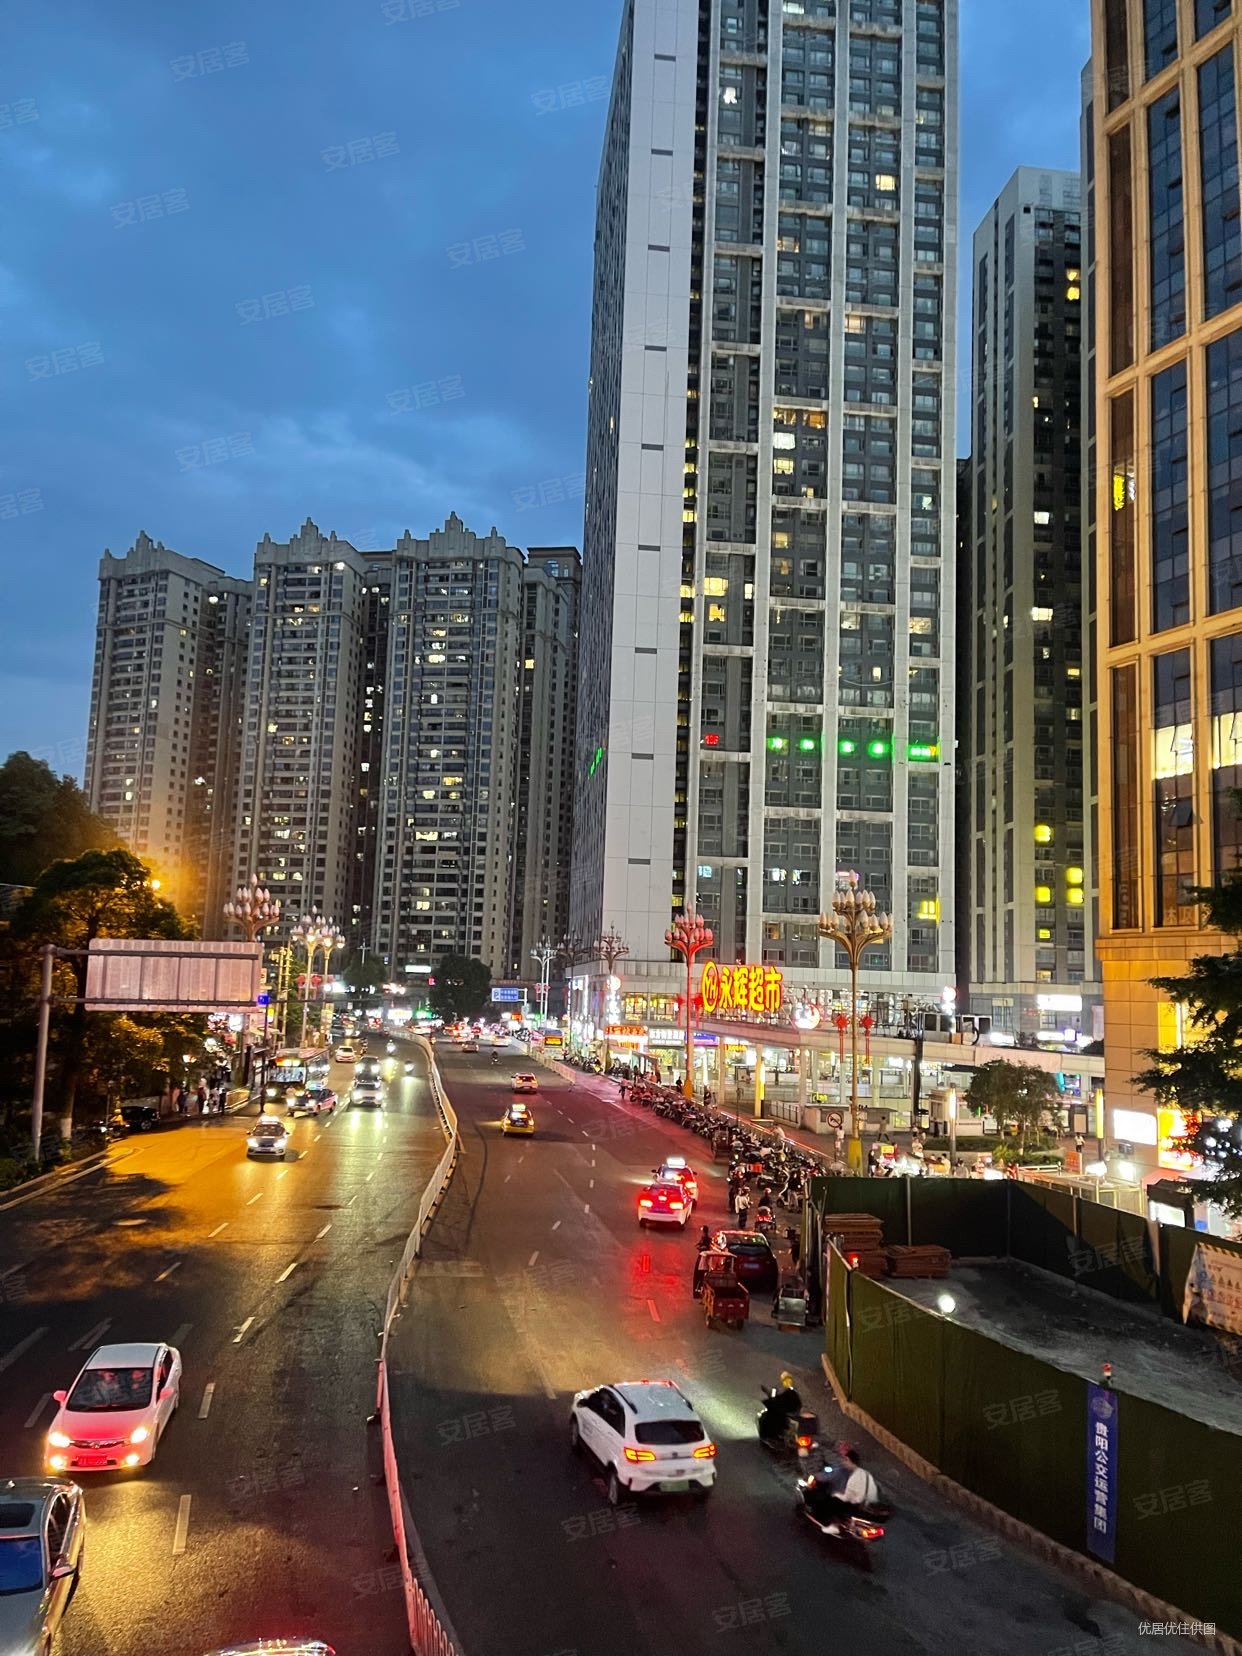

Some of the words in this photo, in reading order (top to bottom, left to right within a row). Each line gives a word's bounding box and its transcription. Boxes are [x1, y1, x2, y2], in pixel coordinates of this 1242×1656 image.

[719, 965, 783, 1013] 永辉超市
[1094, 1421, 1109, 1534] 贵阳公交运营集团
